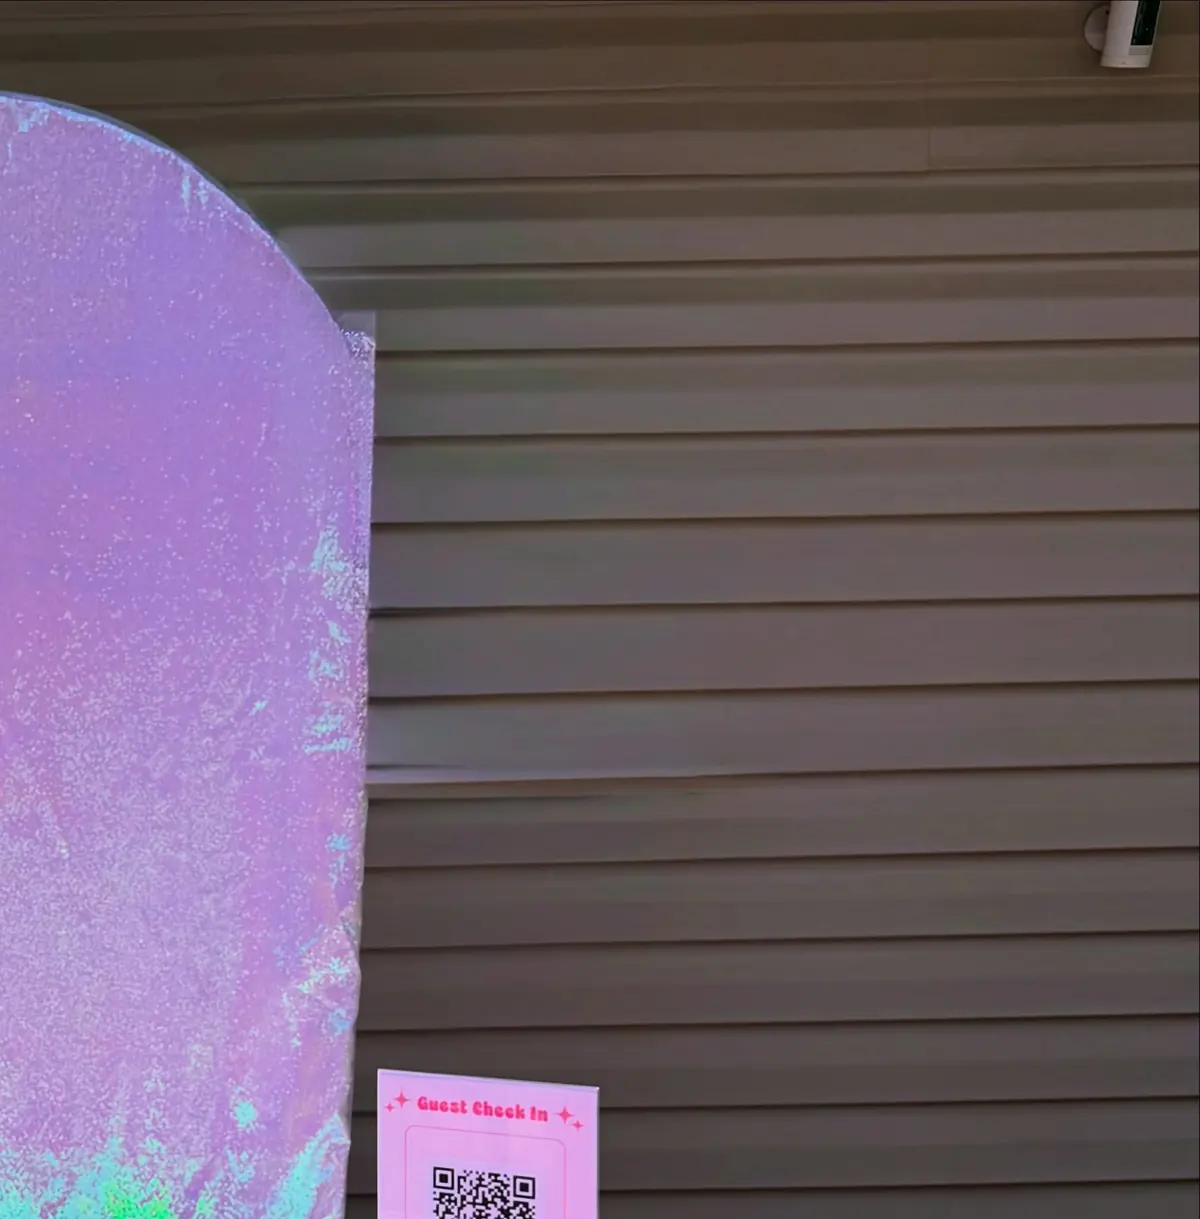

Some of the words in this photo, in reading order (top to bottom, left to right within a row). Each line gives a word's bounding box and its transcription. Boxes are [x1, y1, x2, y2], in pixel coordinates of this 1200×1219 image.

[416, 1096, 468, 1115] Guest
[472, 1101, 526, 1120] Check
[530, 1106, 548, 1122] In
